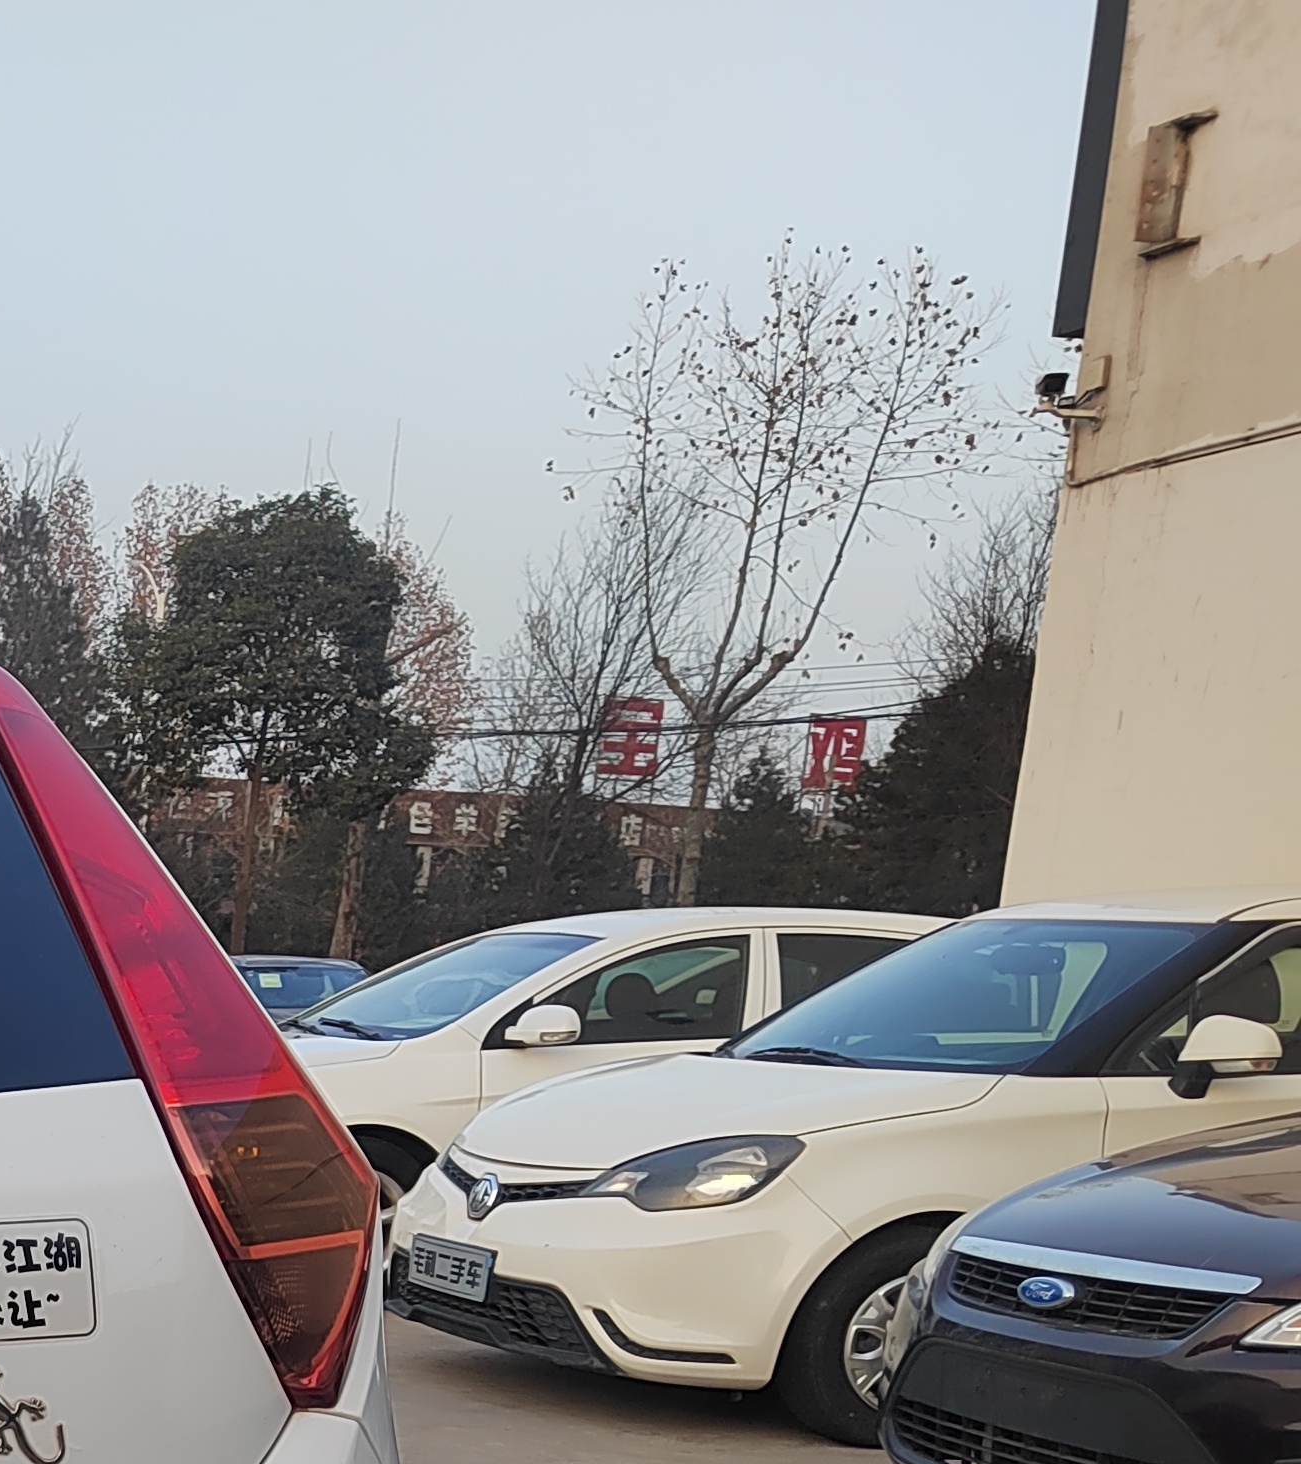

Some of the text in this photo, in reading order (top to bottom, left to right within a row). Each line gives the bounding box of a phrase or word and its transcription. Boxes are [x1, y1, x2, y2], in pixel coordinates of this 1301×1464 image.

[414, 1246, 484, 1289] 毛利二手车
[1025, 1281, 1057, 1301] Ford
